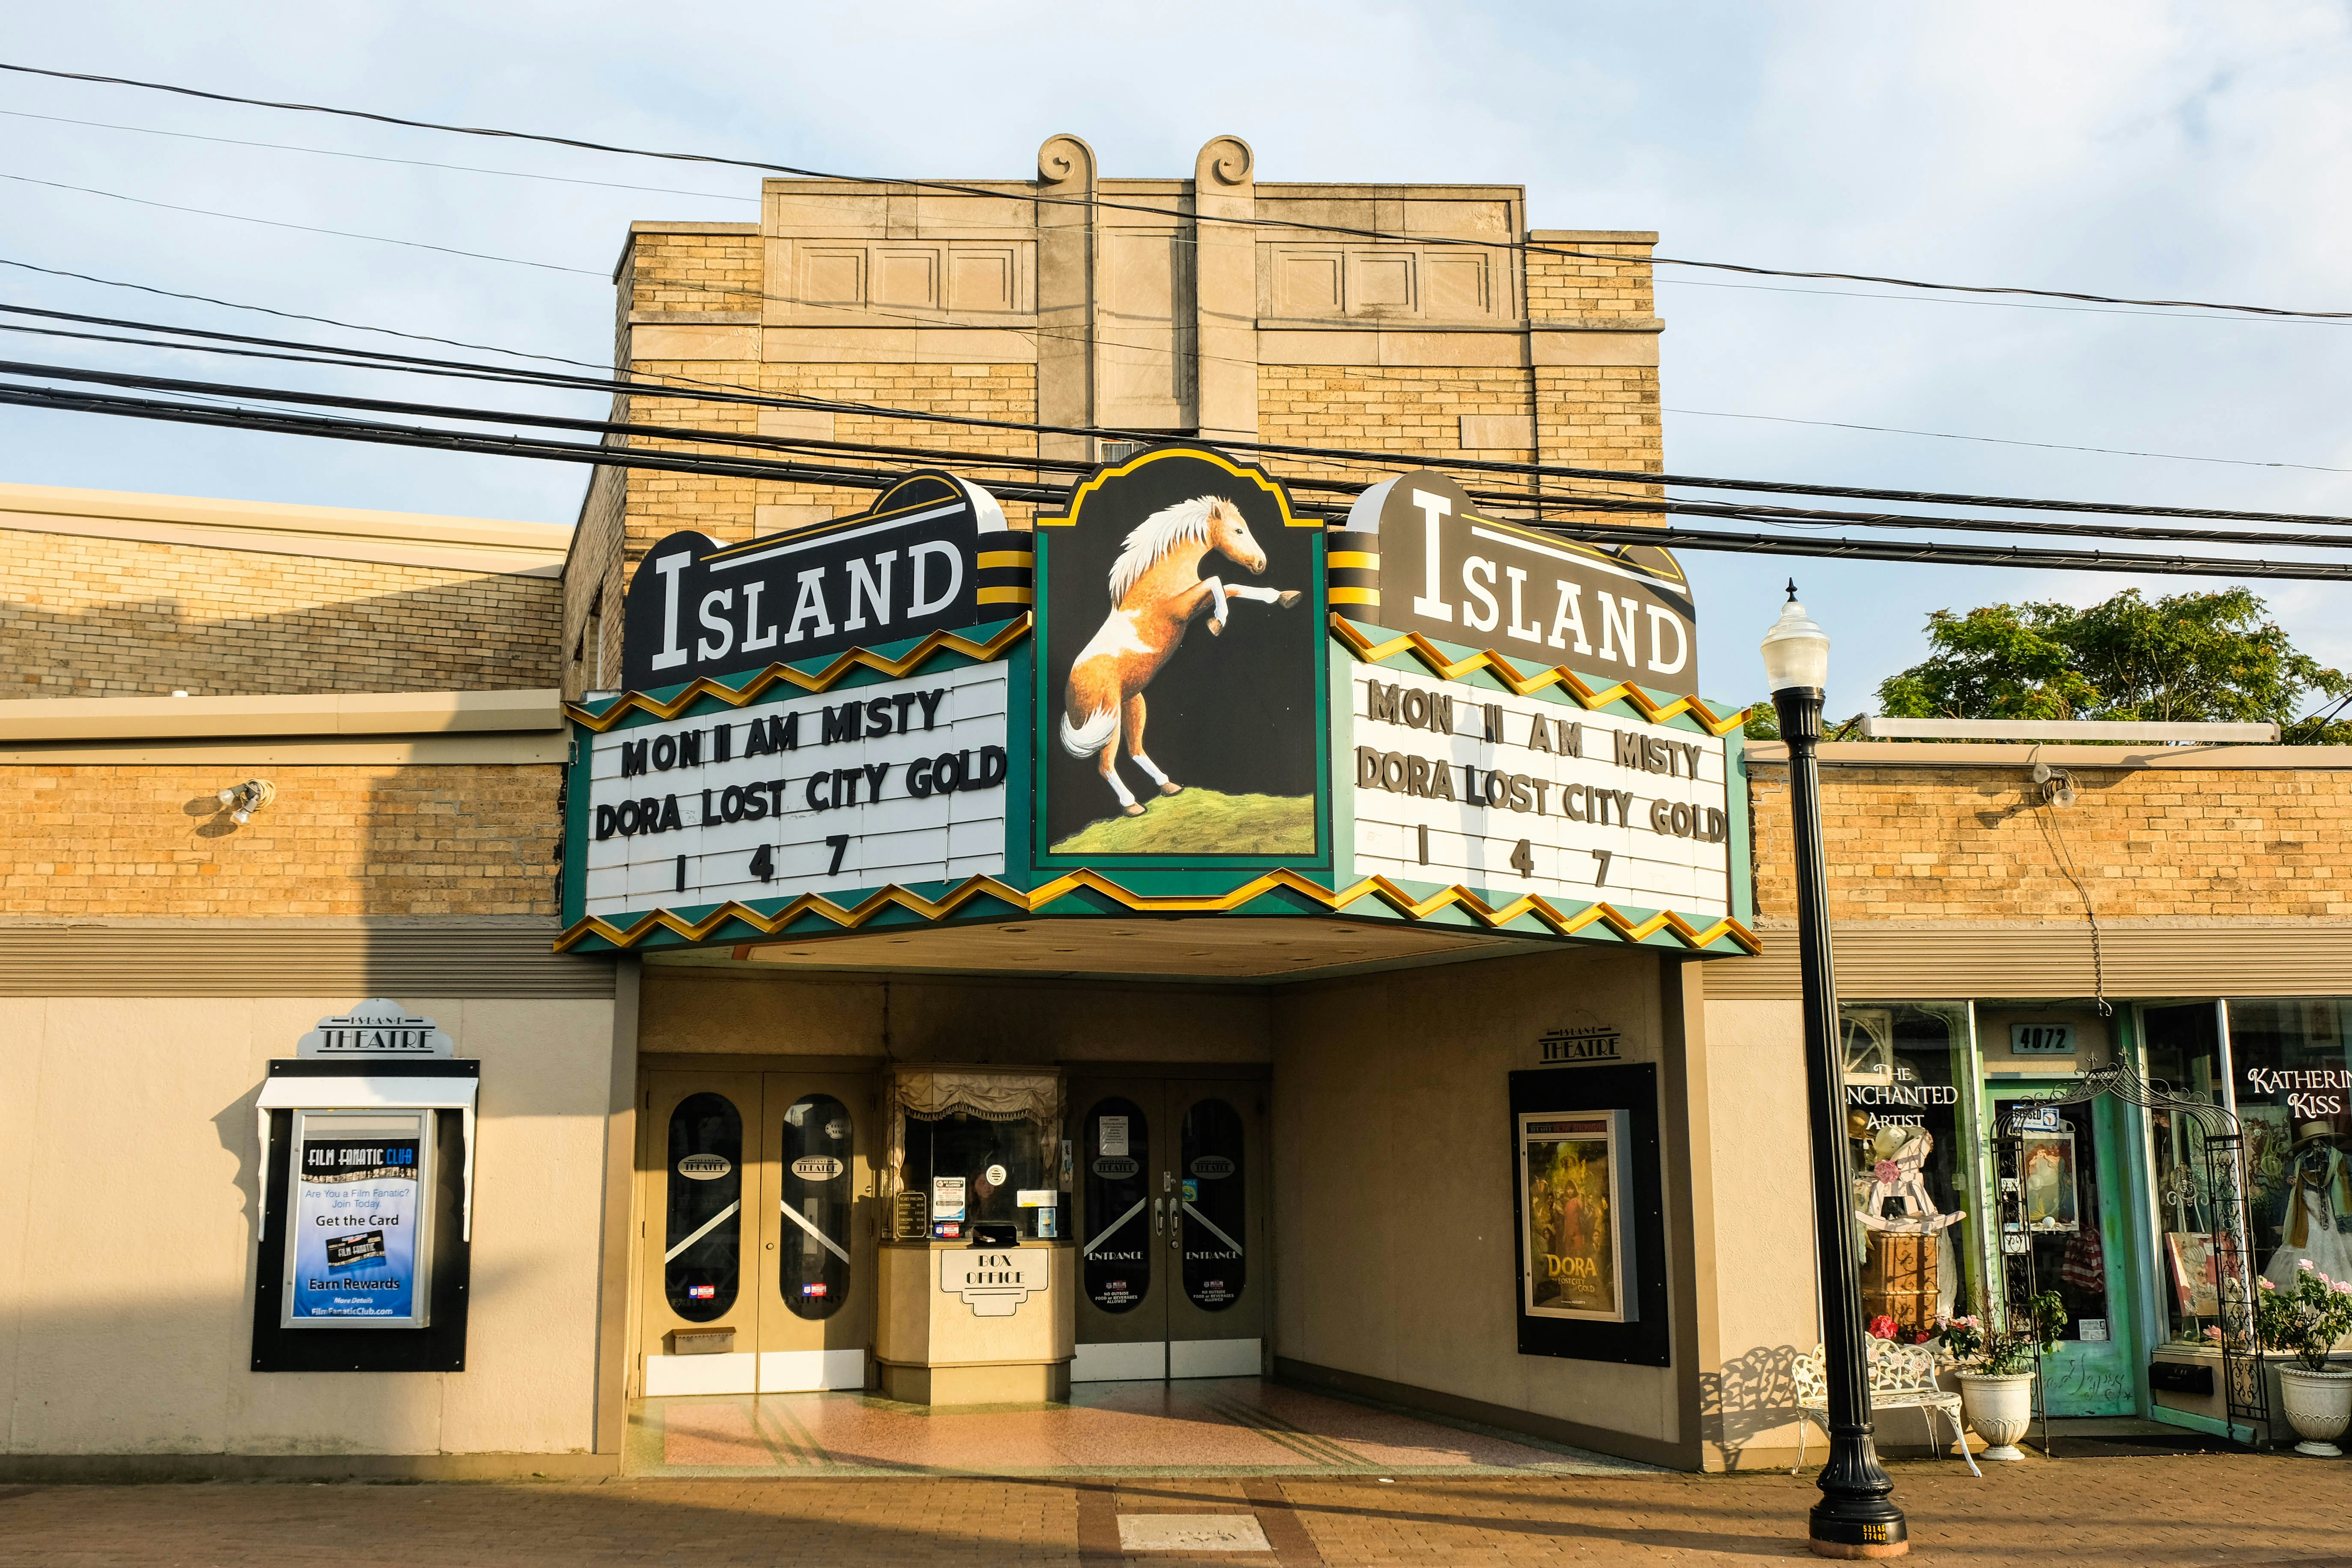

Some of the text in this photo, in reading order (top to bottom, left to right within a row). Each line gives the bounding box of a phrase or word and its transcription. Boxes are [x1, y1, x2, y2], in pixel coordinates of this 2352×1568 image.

[1413, 488, 1688, 675] ISLAND
[652, 540, 963, 671] ISLAND
[621, 729, 700, 778] MON
[744, 712, 798, 757] AM
[821, 688, 944, 745] MISTY
[1368, 679, 1453, 735] MON
[1529, 713, 1583, 759] AM
[1615, 729, 1702, 780] MISTY
[596, 745, 1007, 840] DORA LOST CITY GOLD
[1356, 745, 1726, 844] DORA LOST CITY GOLD
[749, 843, 774, 883] 4
[826, 834, 850, 876] 7
[1510, 838, 1534, 879] 4
[1592, 849, 1612, 888] 7
[319, 1030, 432, 1048] THEATRE
[2021, 1028, 2066, 1049] 4072
[1540, 1037, 1620, 1059] THEATRE
[1873, 1063, 1912, 1081] THE
[1845, 1086, 1959, 1105] NCHANTED
[2287, 1093, 2341, 1118] KISS
[1866, 1112, 1925, 1130] ARTIST
[308, 1148, 412, 1166] FILM FANATIC CLUB
[305, 1189, 321, 1198] Are
[325, 1189, 340, 1198] You
[351, 1189, 370, 1198] Film
[373, 1189, 409, 1198] Fanatic?
[332, 1200, 350, 1208] Join
[316, 1214, 399, 1226] Get the Card
[978, 1255, 1012, 1267] BOX
[1089, 1251, 1144, 1261] ENTRANCE
[1186, 1251, 1239, 1260] ENTRANCE
[1547, 1254, 1597, 1278] DORA
[308, 1277, 400, 1291] Earn Rewards
[966, 1271, 1025, 1285] OFFICE
[311, 1307, 393, 1315] FilmFanaticClub.com
[1863, 1524, 1885, 1532] 53145
